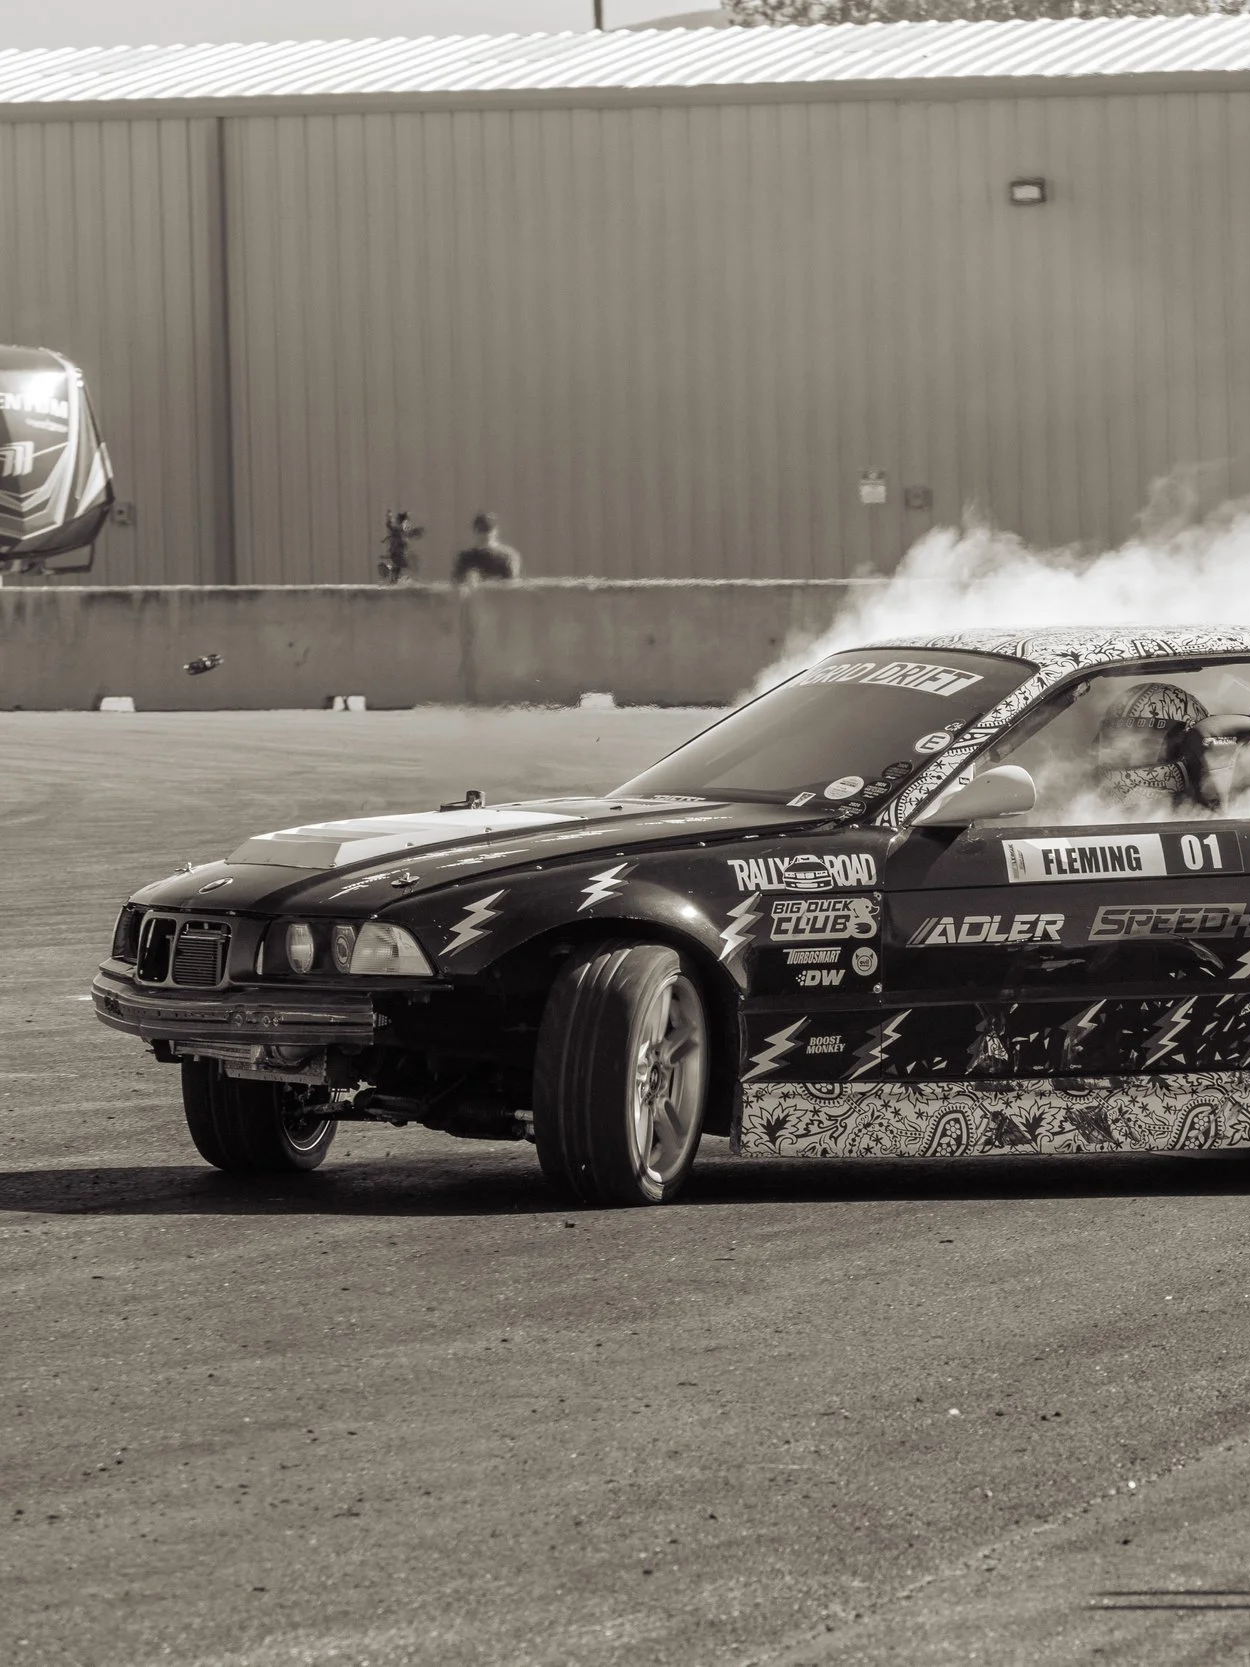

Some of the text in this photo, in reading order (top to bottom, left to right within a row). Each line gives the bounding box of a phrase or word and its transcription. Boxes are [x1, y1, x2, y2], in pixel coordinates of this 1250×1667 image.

[866, 663, 976, 692] DRIFT
[1041, 844, 1144, 876] FLEMING
[1180, 833, 1223, 870] 01
[727, 853, 878, 892] RALLY ROAD
[772, 900, 853, 915] BIG DUCK
[772, 914, 851, 936] CLUB
[924, 913, 1065, 944] ADLER
[782, 946, 842, 965] TURBOSMART
[804, 969, 846, 986] DW
[805, 1043, 846, 1054] MONKEY
[809, 1035, 842, 1046] BOOST
